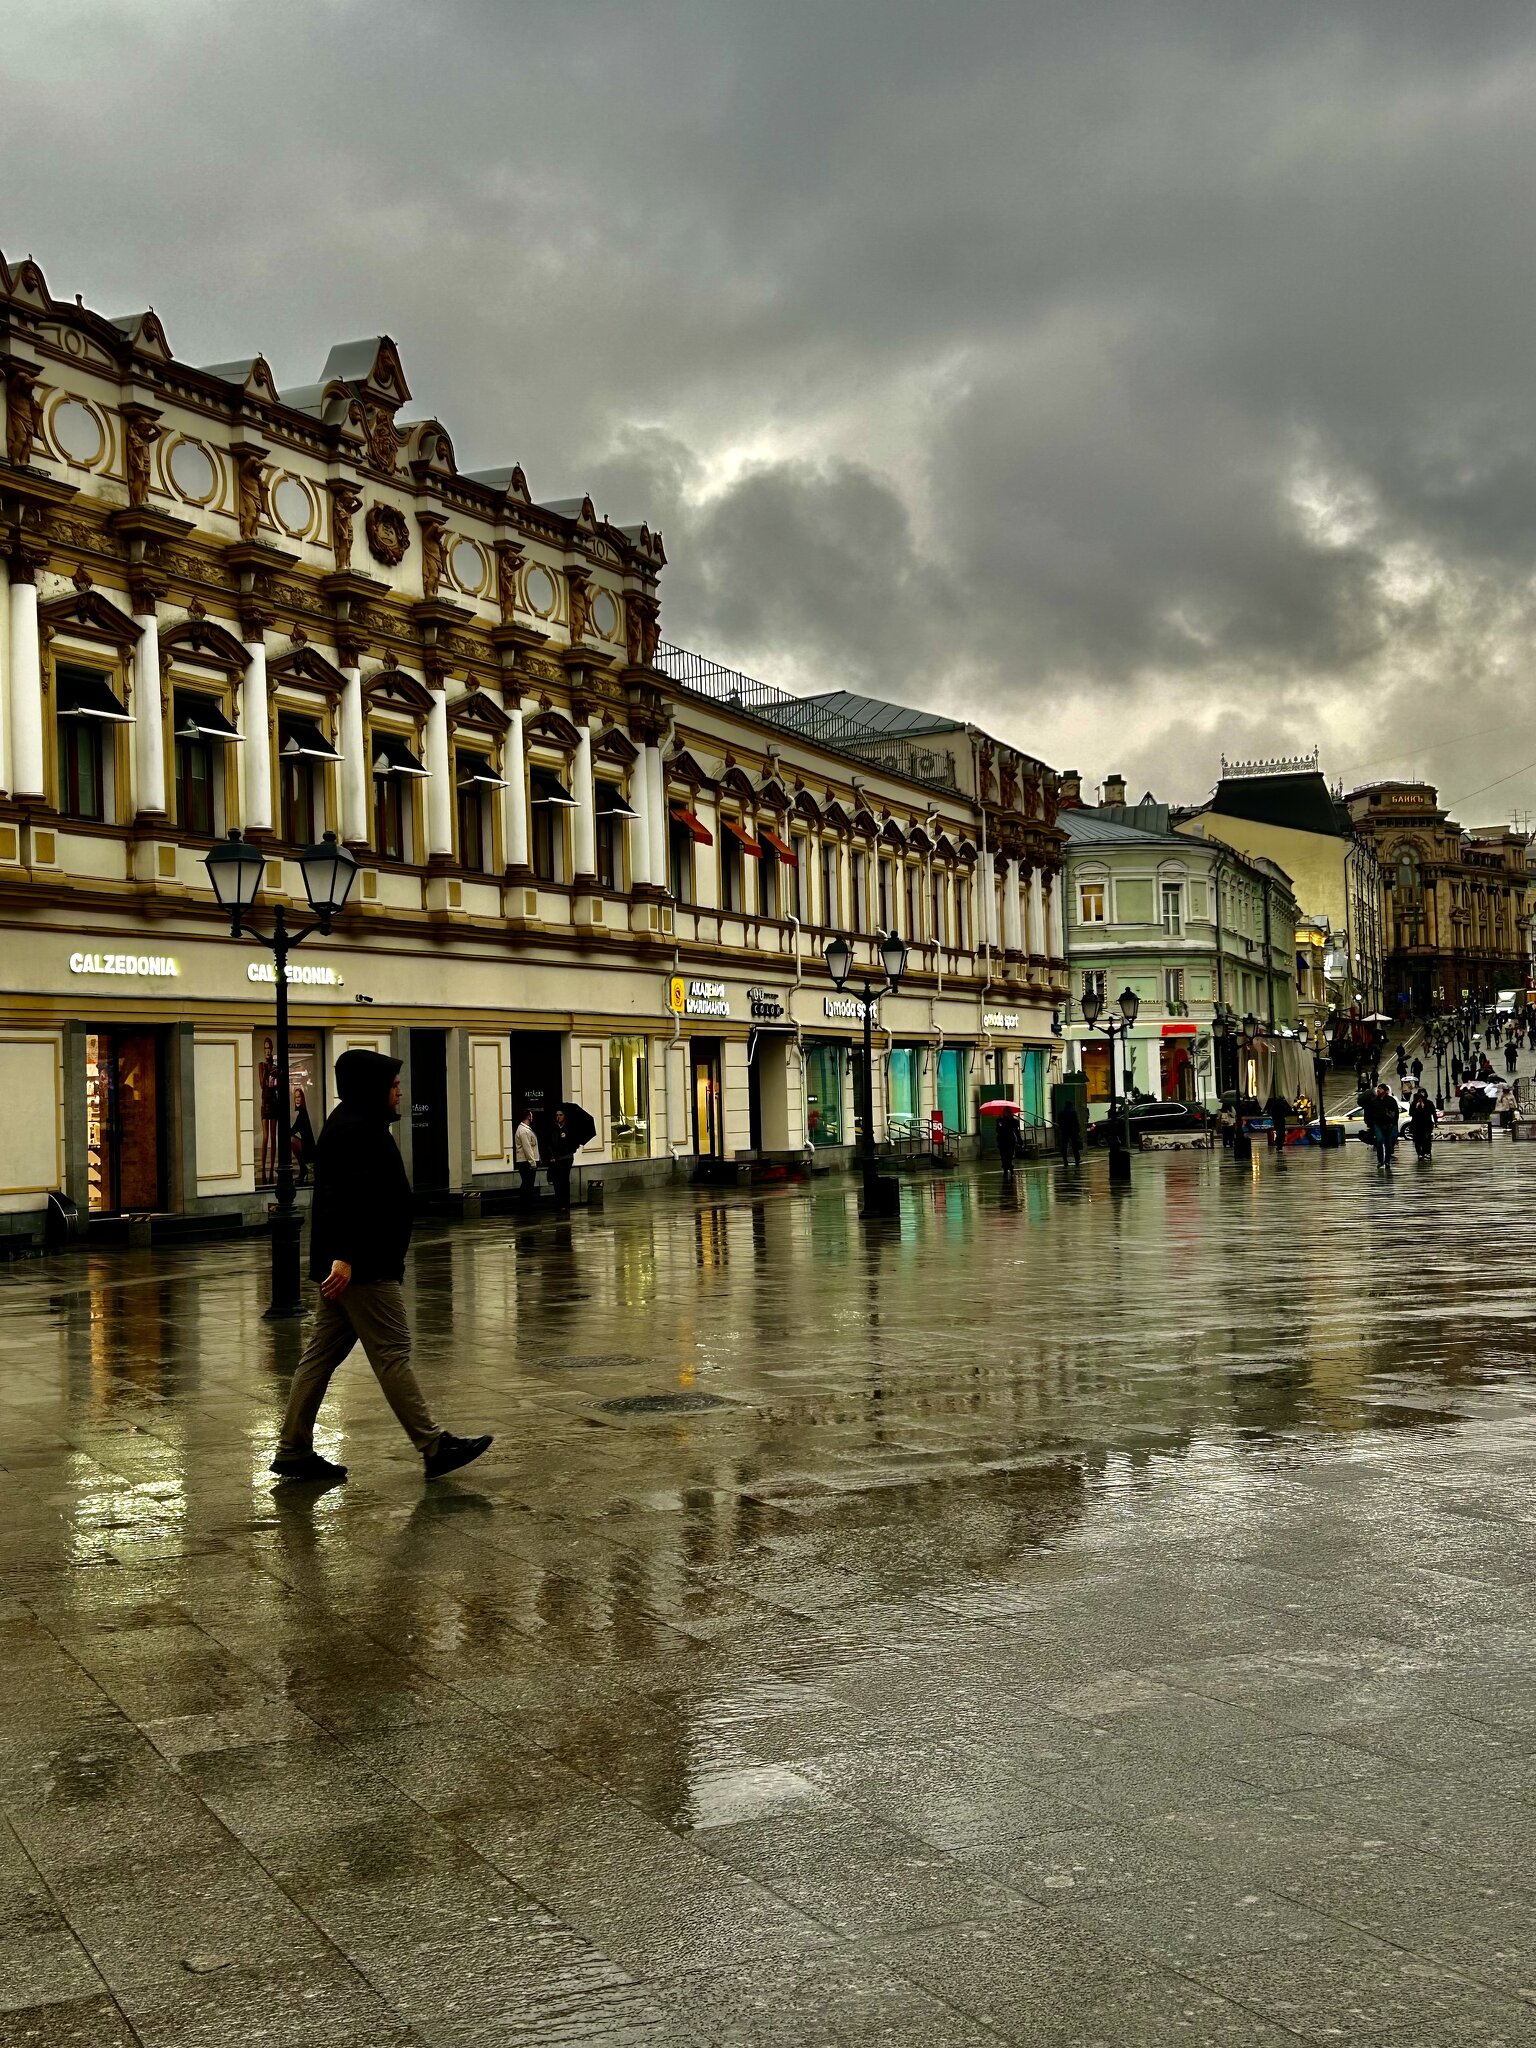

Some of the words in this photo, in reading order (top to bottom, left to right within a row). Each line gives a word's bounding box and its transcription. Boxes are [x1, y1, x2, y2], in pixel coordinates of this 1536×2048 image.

[1391, 795, 1424, 803] БАНКЪ
[69, 952, 179, 977] CALZEDONIA
[247, 963, 337, 985] CALEDONIA
[690, 981, 725, 999] АКАДЕМИЯ
[824, 996, 857, 1017] lamoda
[857, 1001, 878, 1021] sprt
[983, 1012, 1004, 1027] amoda
